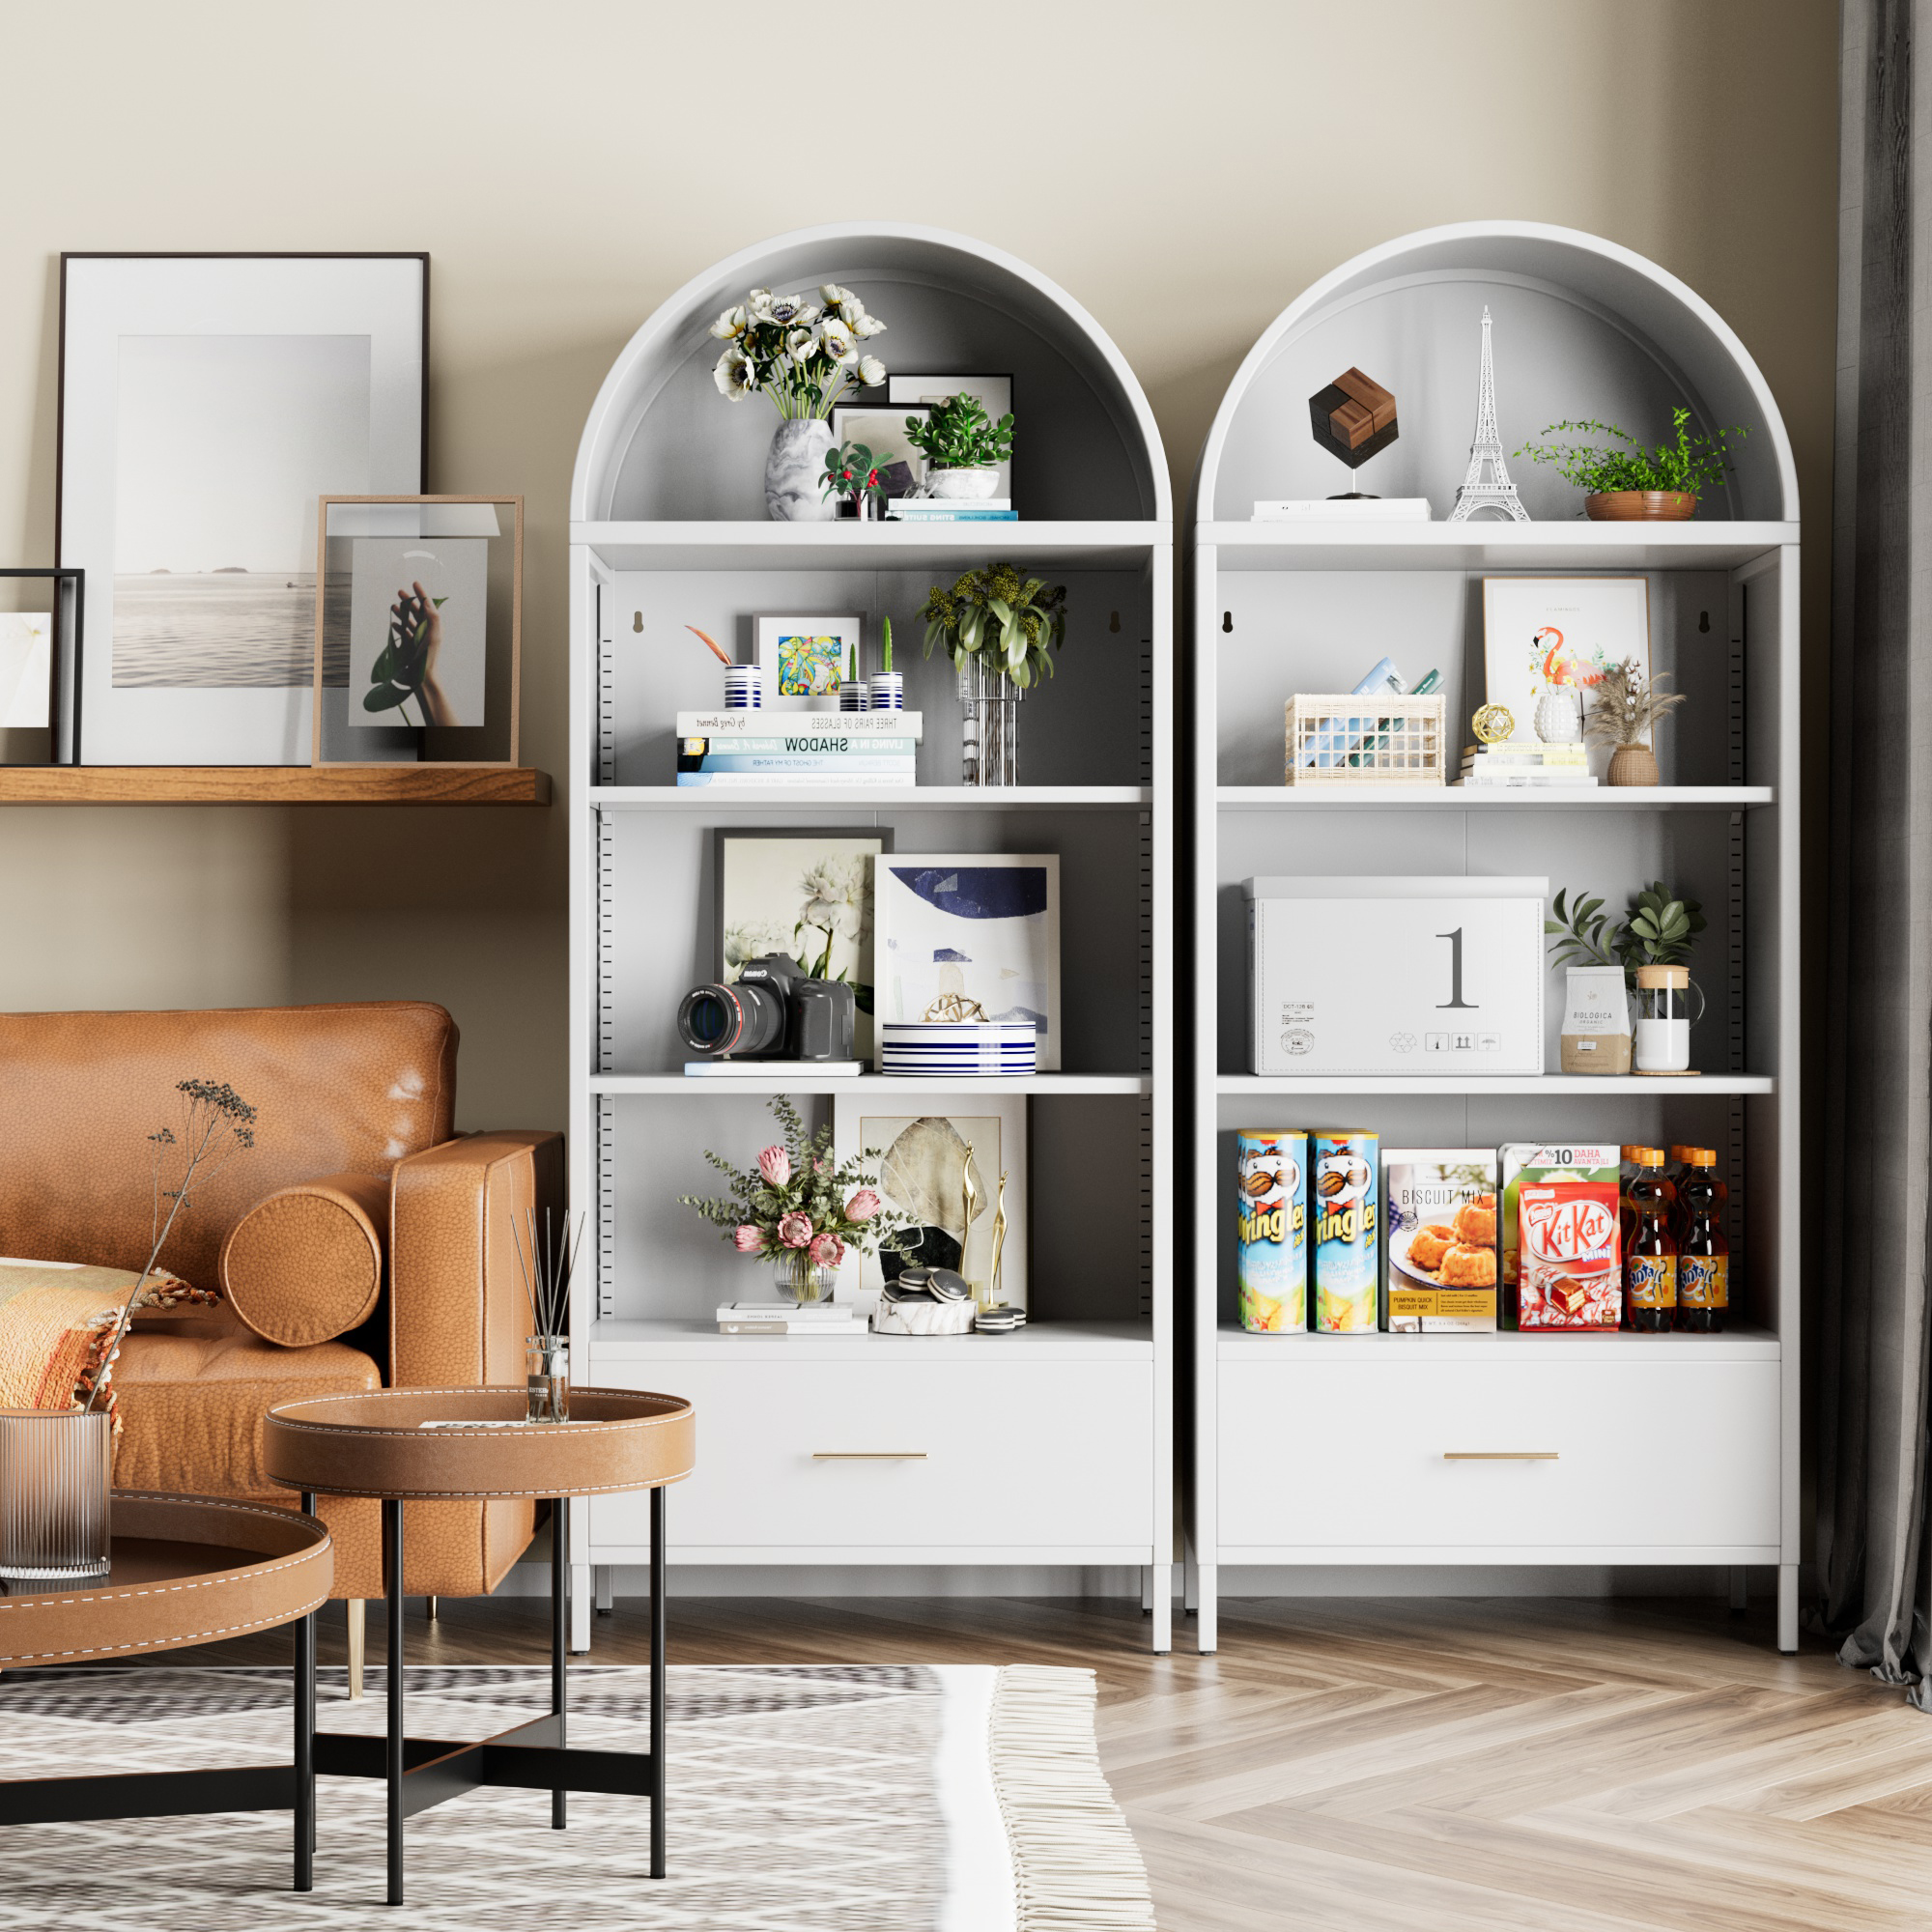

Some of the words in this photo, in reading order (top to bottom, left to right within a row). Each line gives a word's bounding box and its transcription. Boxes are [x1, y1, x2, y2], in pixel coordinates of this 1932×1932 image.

[1435, 927, 1479, 1009] 1
[1546, 1149, 1573, 1165] %10
[1574, 1149, 1601, 1158] DAHA
[1402, 1189, 1454, 1205] BISCUIT
[1462, 1189, 1484, 1205] MIX
[1543, 1205, 1605, 1257] KitKat
